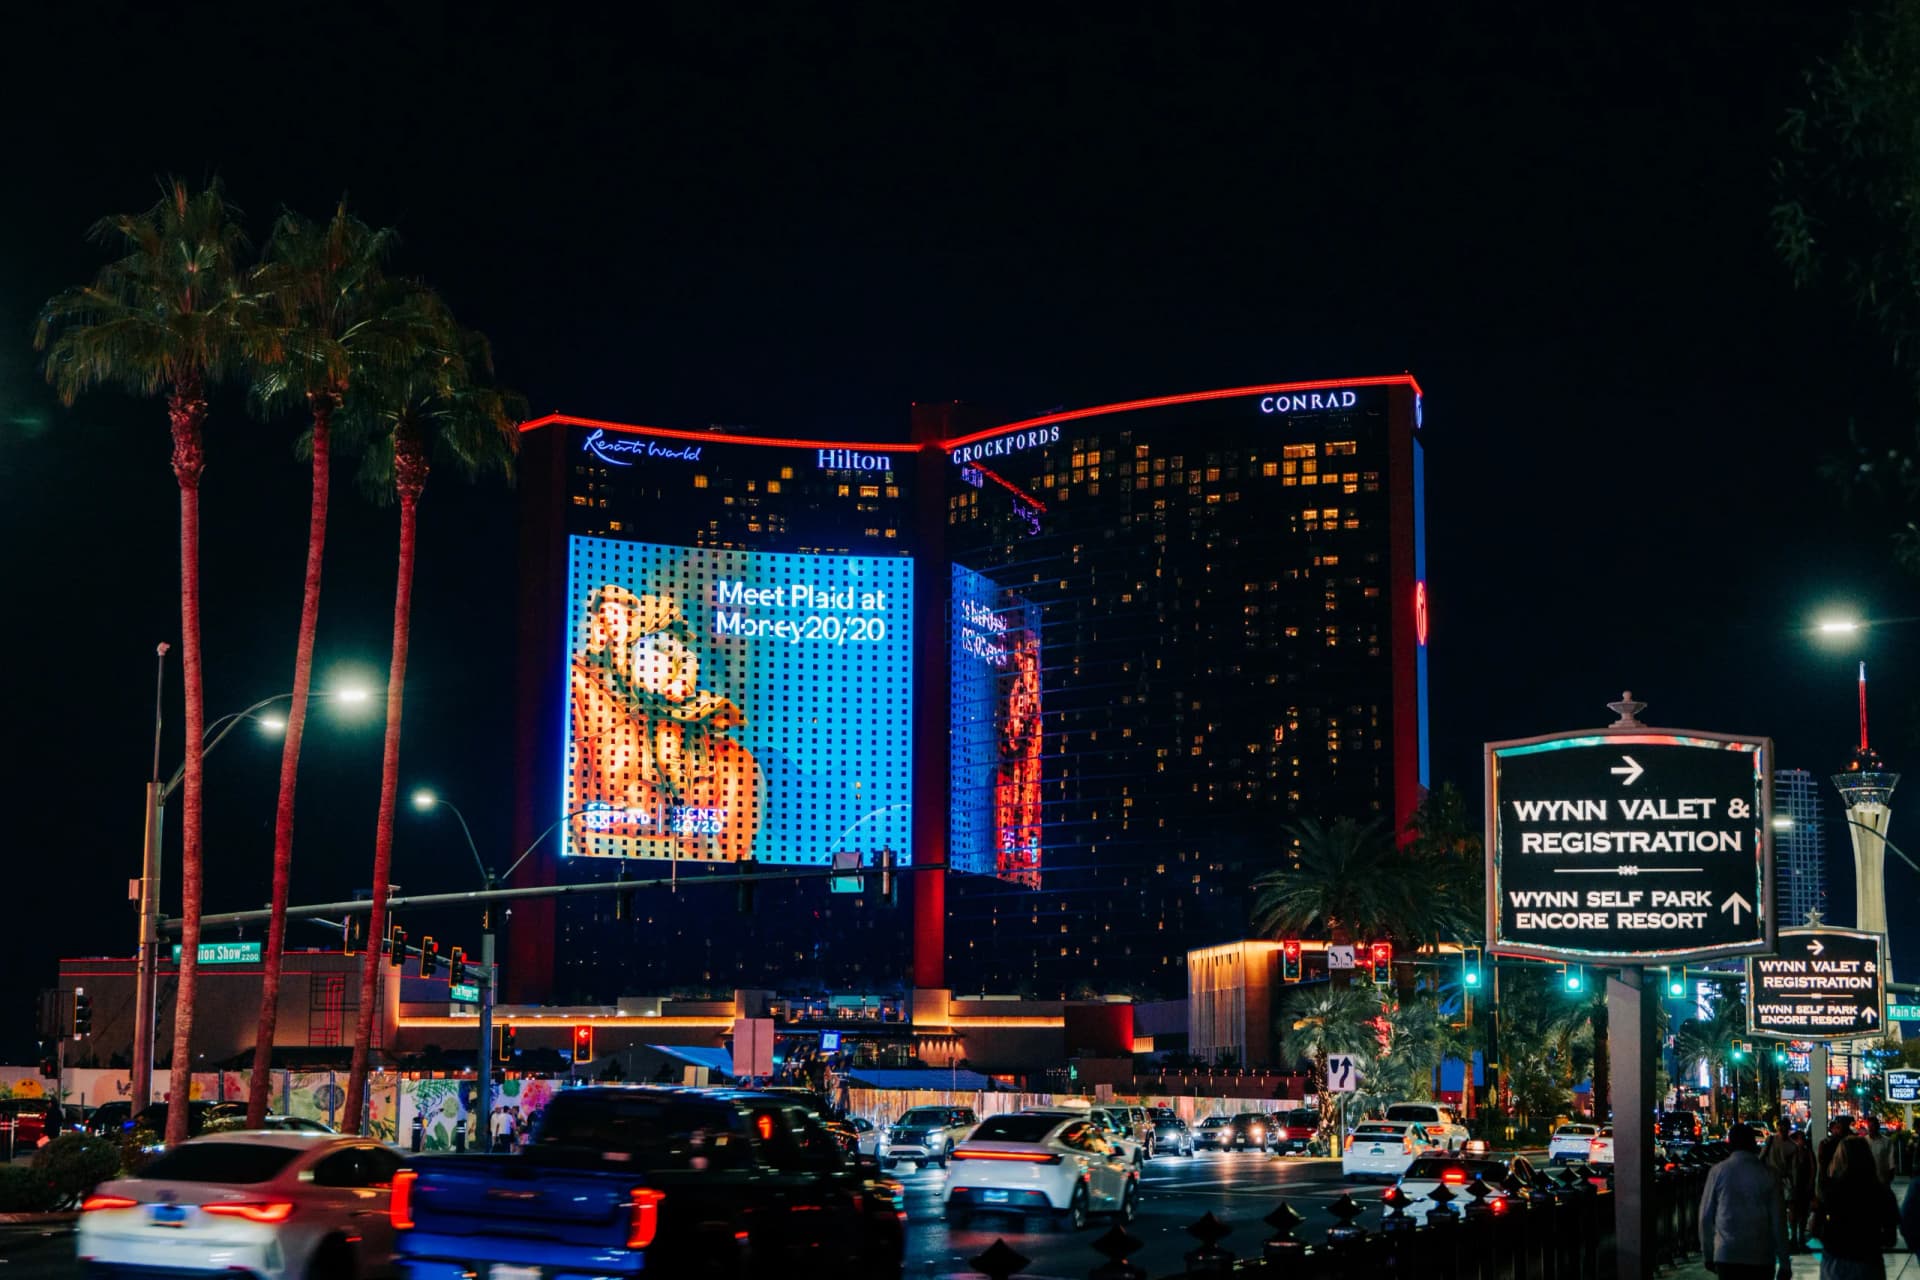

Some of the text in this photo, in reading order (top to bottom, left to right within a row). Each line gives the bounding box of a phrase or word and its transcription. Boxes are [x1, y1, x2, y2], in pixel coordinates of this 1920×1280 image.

[1260, 391, 1356, 413] CONRAD
[584, 428, 702, 465] Resorts World
[952, 425, 1060, 464] CROCKFORDS
[817, 449, 891, 470] Hilton
[718, 580, 886, 611] Meet Plaid at
[716, 611, 886, 646] Money20/20
[1513, 798, 1750, 821] WYNN VALET &
[1521, 831, 1742, 854] REGISTRATION
[1510, 891, 1712, 908] WYNN SELF PARK
[1516, 912, 1707, 929] ENCORE RESORT
[217, 945, 241, 960] Show
[1759, 961, 1876, 973] WYNN VALET &
[1763, 977, 1872, 988] REGISTRATION
[1758, 1005, 1858, 1014] WYNN SELF PARK
[1889, 1007, 1909, 1017] Main
[1761, 1016, 1856, 1025] ENCORE RESORT
